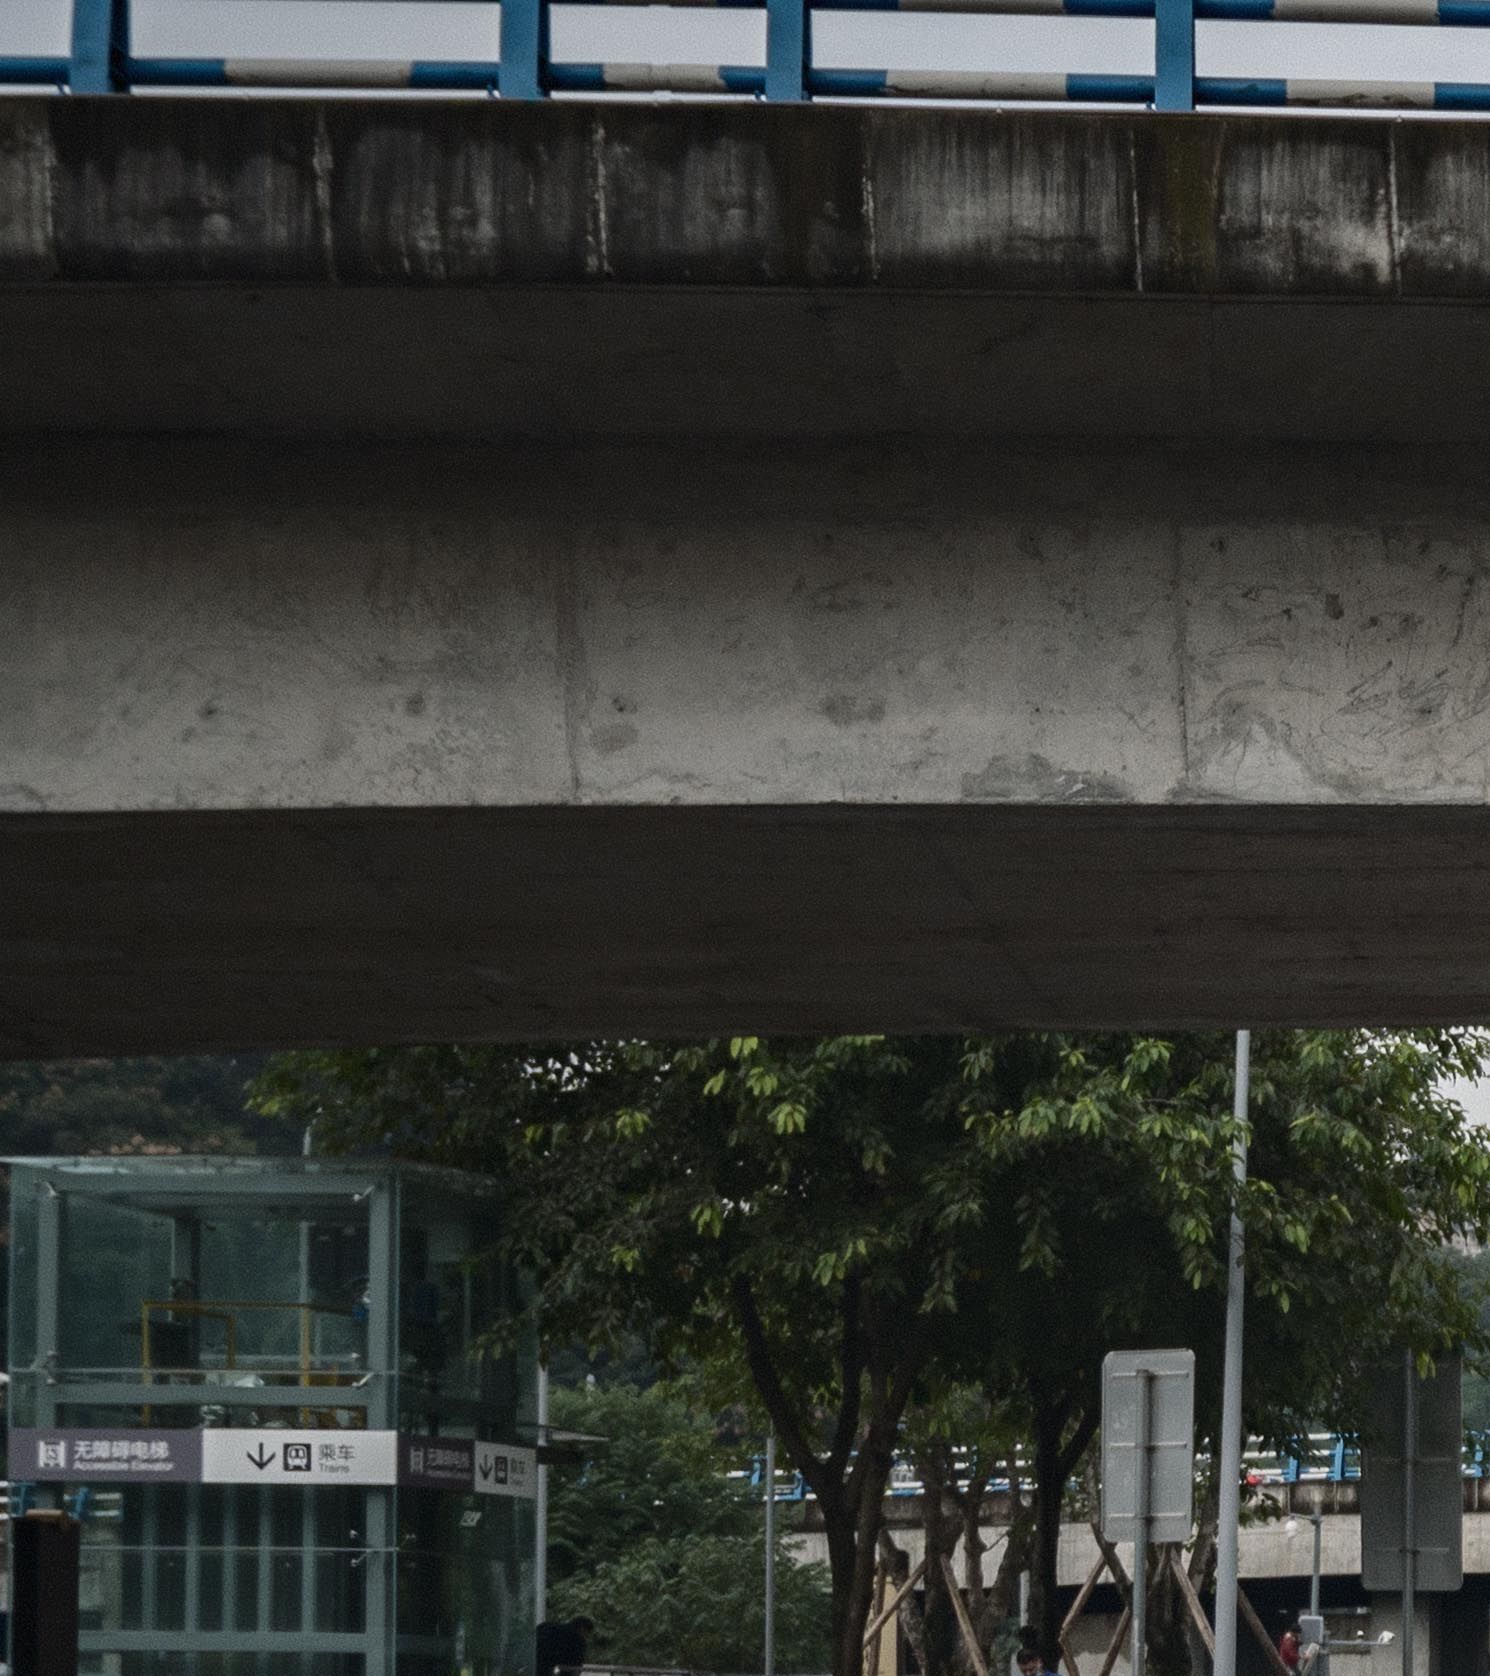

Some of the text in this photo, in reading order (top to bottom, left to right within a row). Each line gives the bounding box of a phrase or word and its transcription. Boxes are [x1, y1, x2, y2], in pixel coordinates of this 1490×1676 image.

[73, 1440, 169, 1460] 无障碍电梯
[319, 1444, 355, 1460] 乘车
